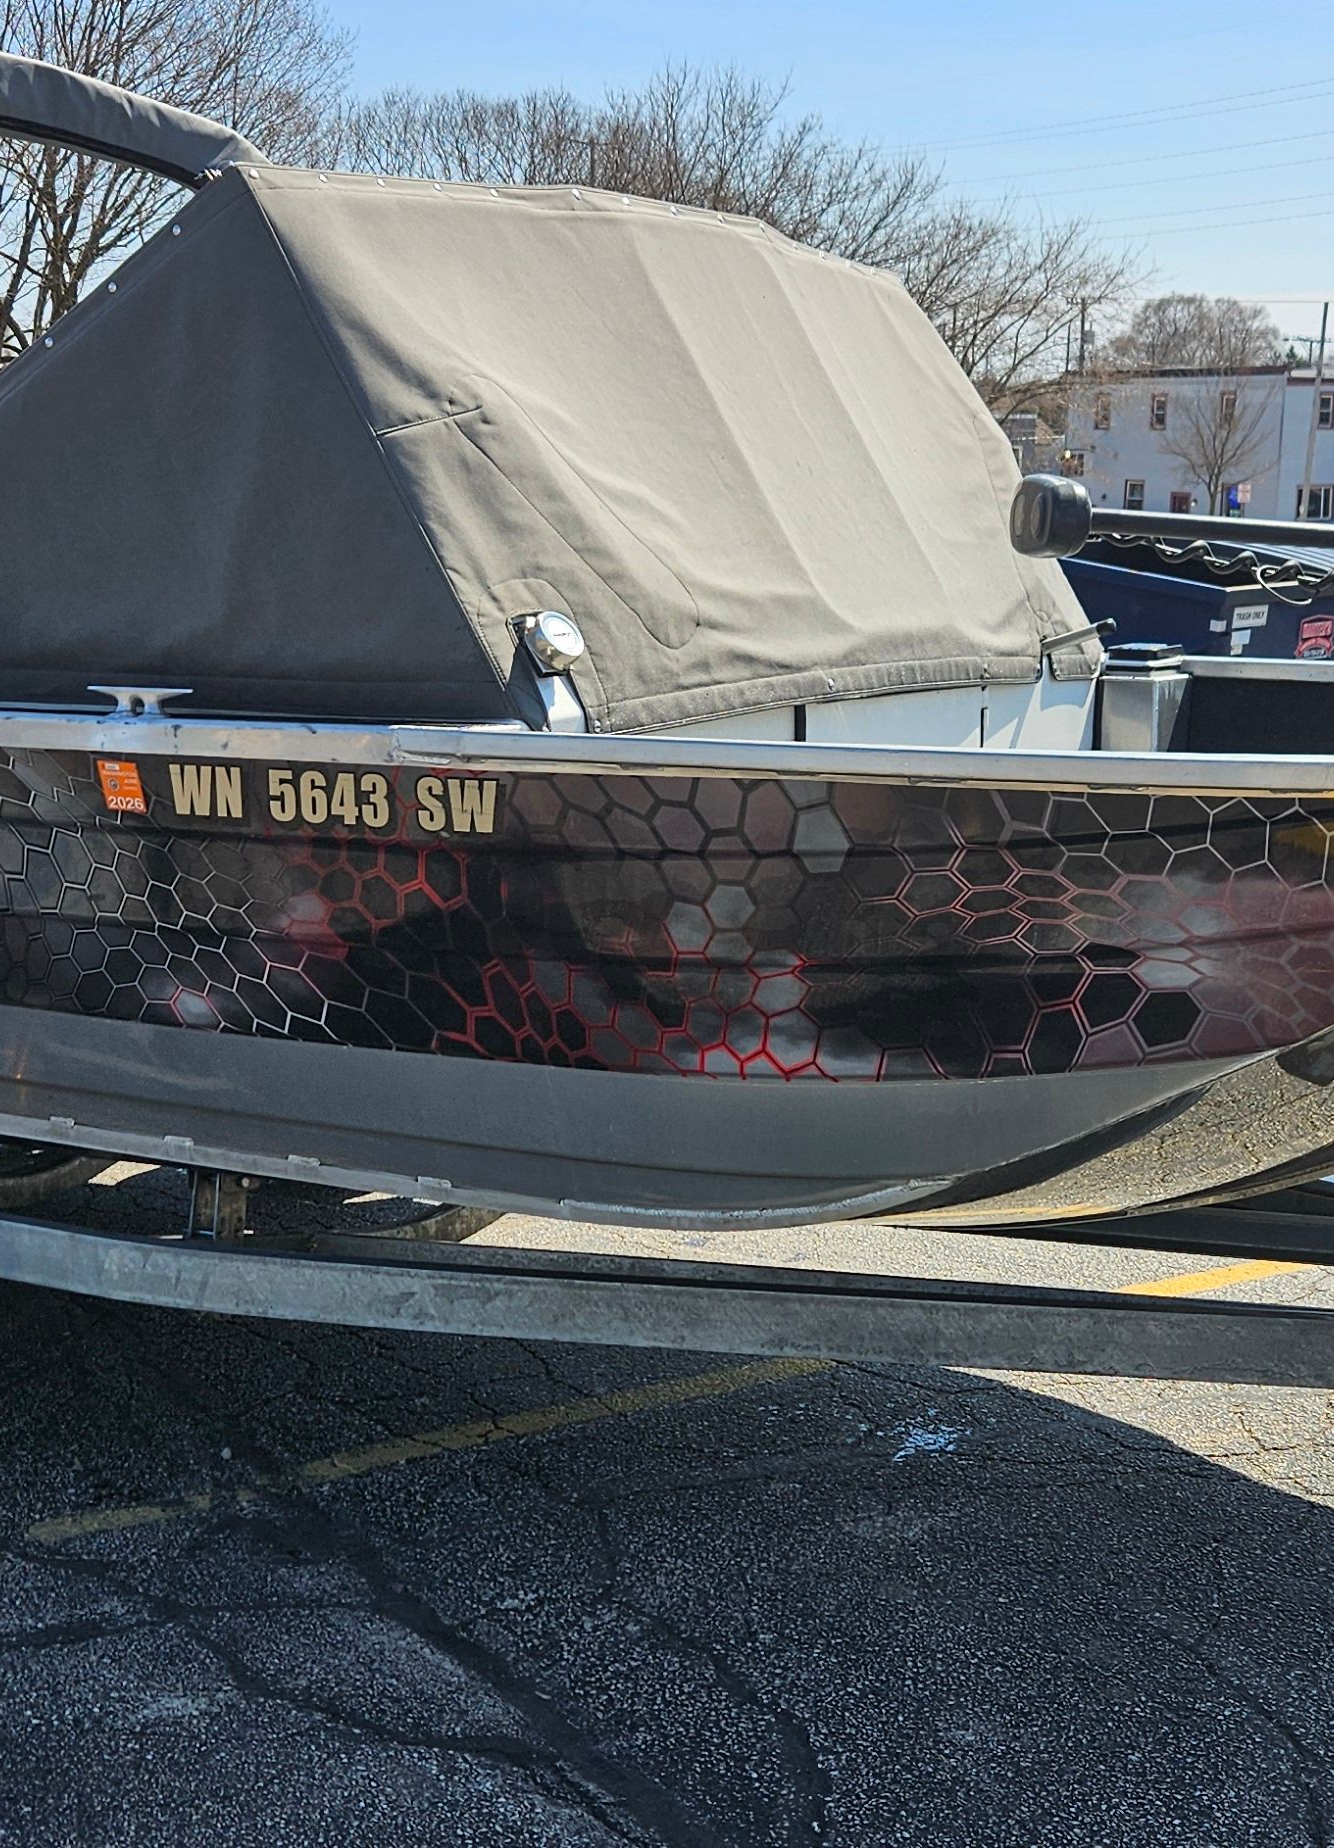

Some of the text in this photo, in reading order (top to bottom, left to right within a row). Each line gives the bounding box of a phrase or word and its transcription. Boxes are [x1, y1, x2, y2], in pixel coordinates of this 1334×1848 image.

[1236, 610, 1265, 621] TRASH ONLY
[108, 796, 144, 810] 2026
[169, 763, 497, 833] WN 5643 SW
